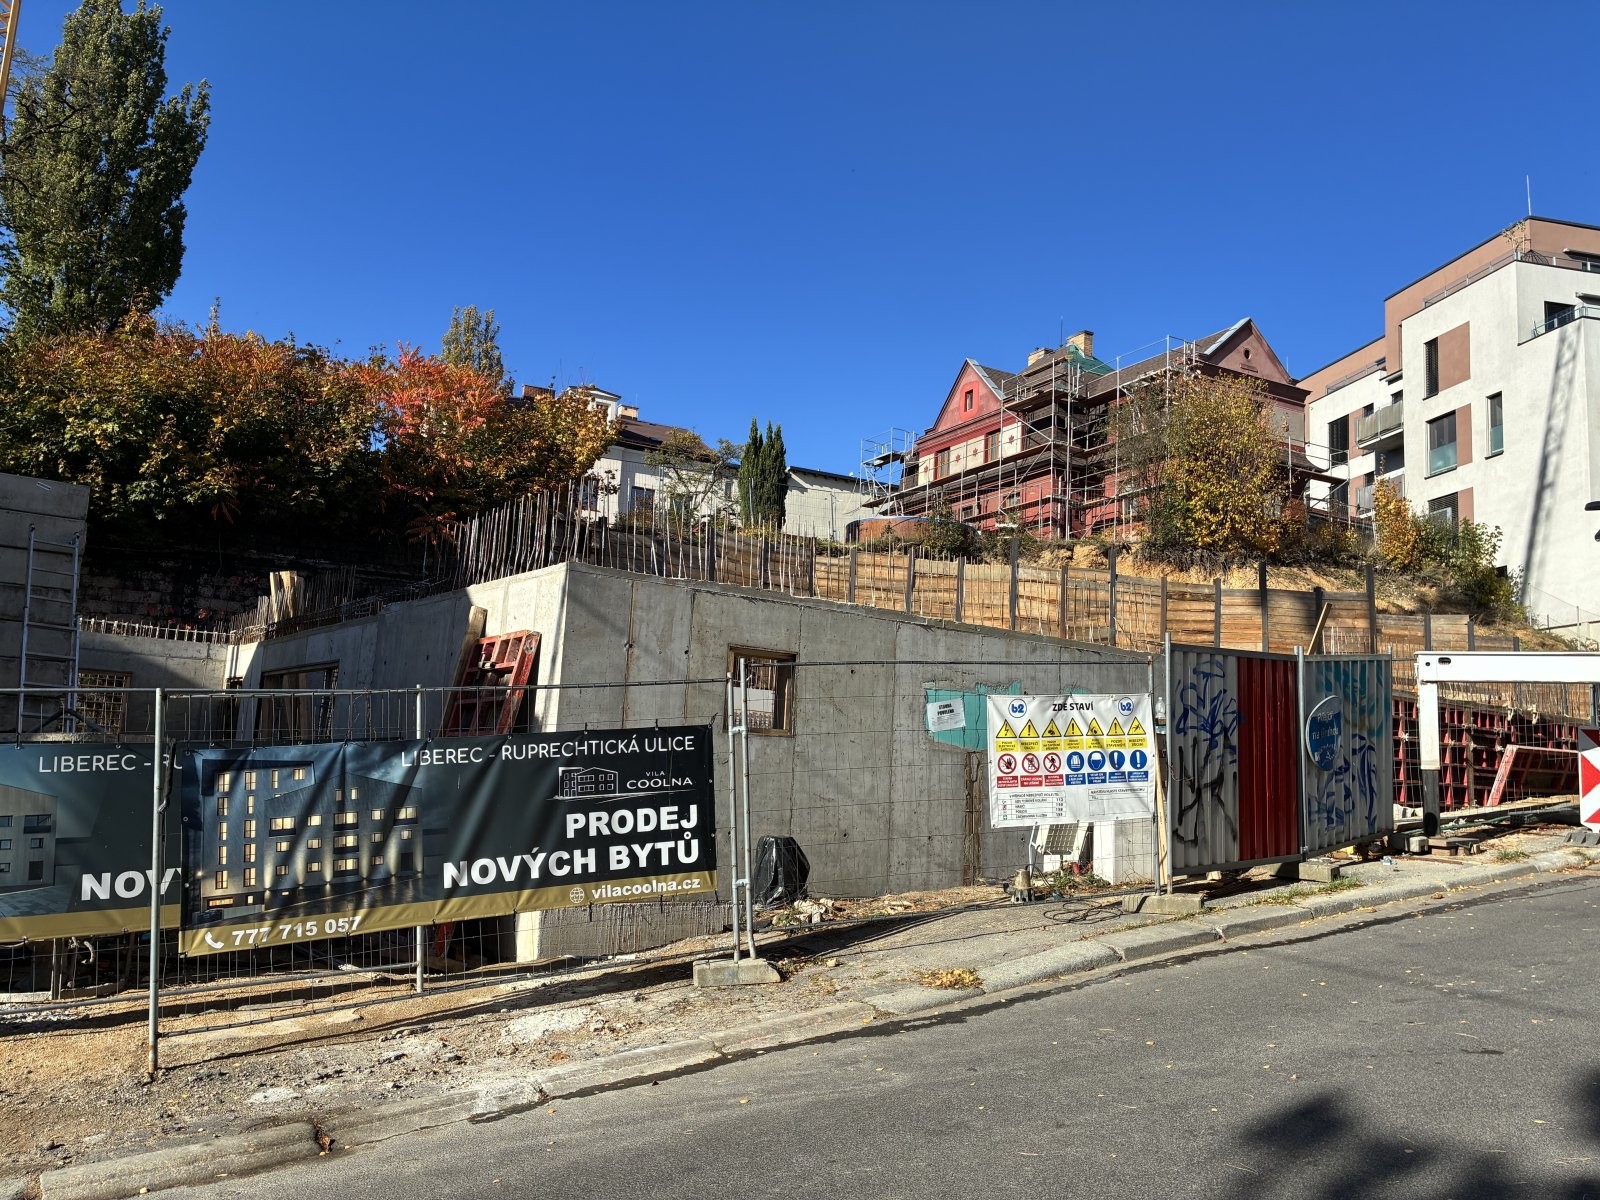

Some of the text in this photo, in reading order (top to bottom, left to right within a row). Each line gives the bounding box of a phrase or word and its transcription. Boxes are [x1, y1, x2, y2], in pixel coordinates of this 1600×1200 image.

[1011, 704, 1025, 713] b2
[1052, 701, 1094, 712] ZDE STAVÍ
[1120, 702, 1132, 712] b2
[402, 748, 484, 768] LIBEREC
[501, 734, 640, 760] RUPRECHTICKÁ
[644, 736, 696, 752] ULICE
[38, 755, 137, 773] LIBEREC
[626, 777, 693, 790] COOLNA
[566, 804, 698, 839] PRODEJ
[443, 831, 699, 889] NOVÝCH BYTŮ
[81, 867, 182, 901] NOV
[591, 877, 701, 899] vilacoolna.cz
[232, 915, 362, 947] 777 715 057
